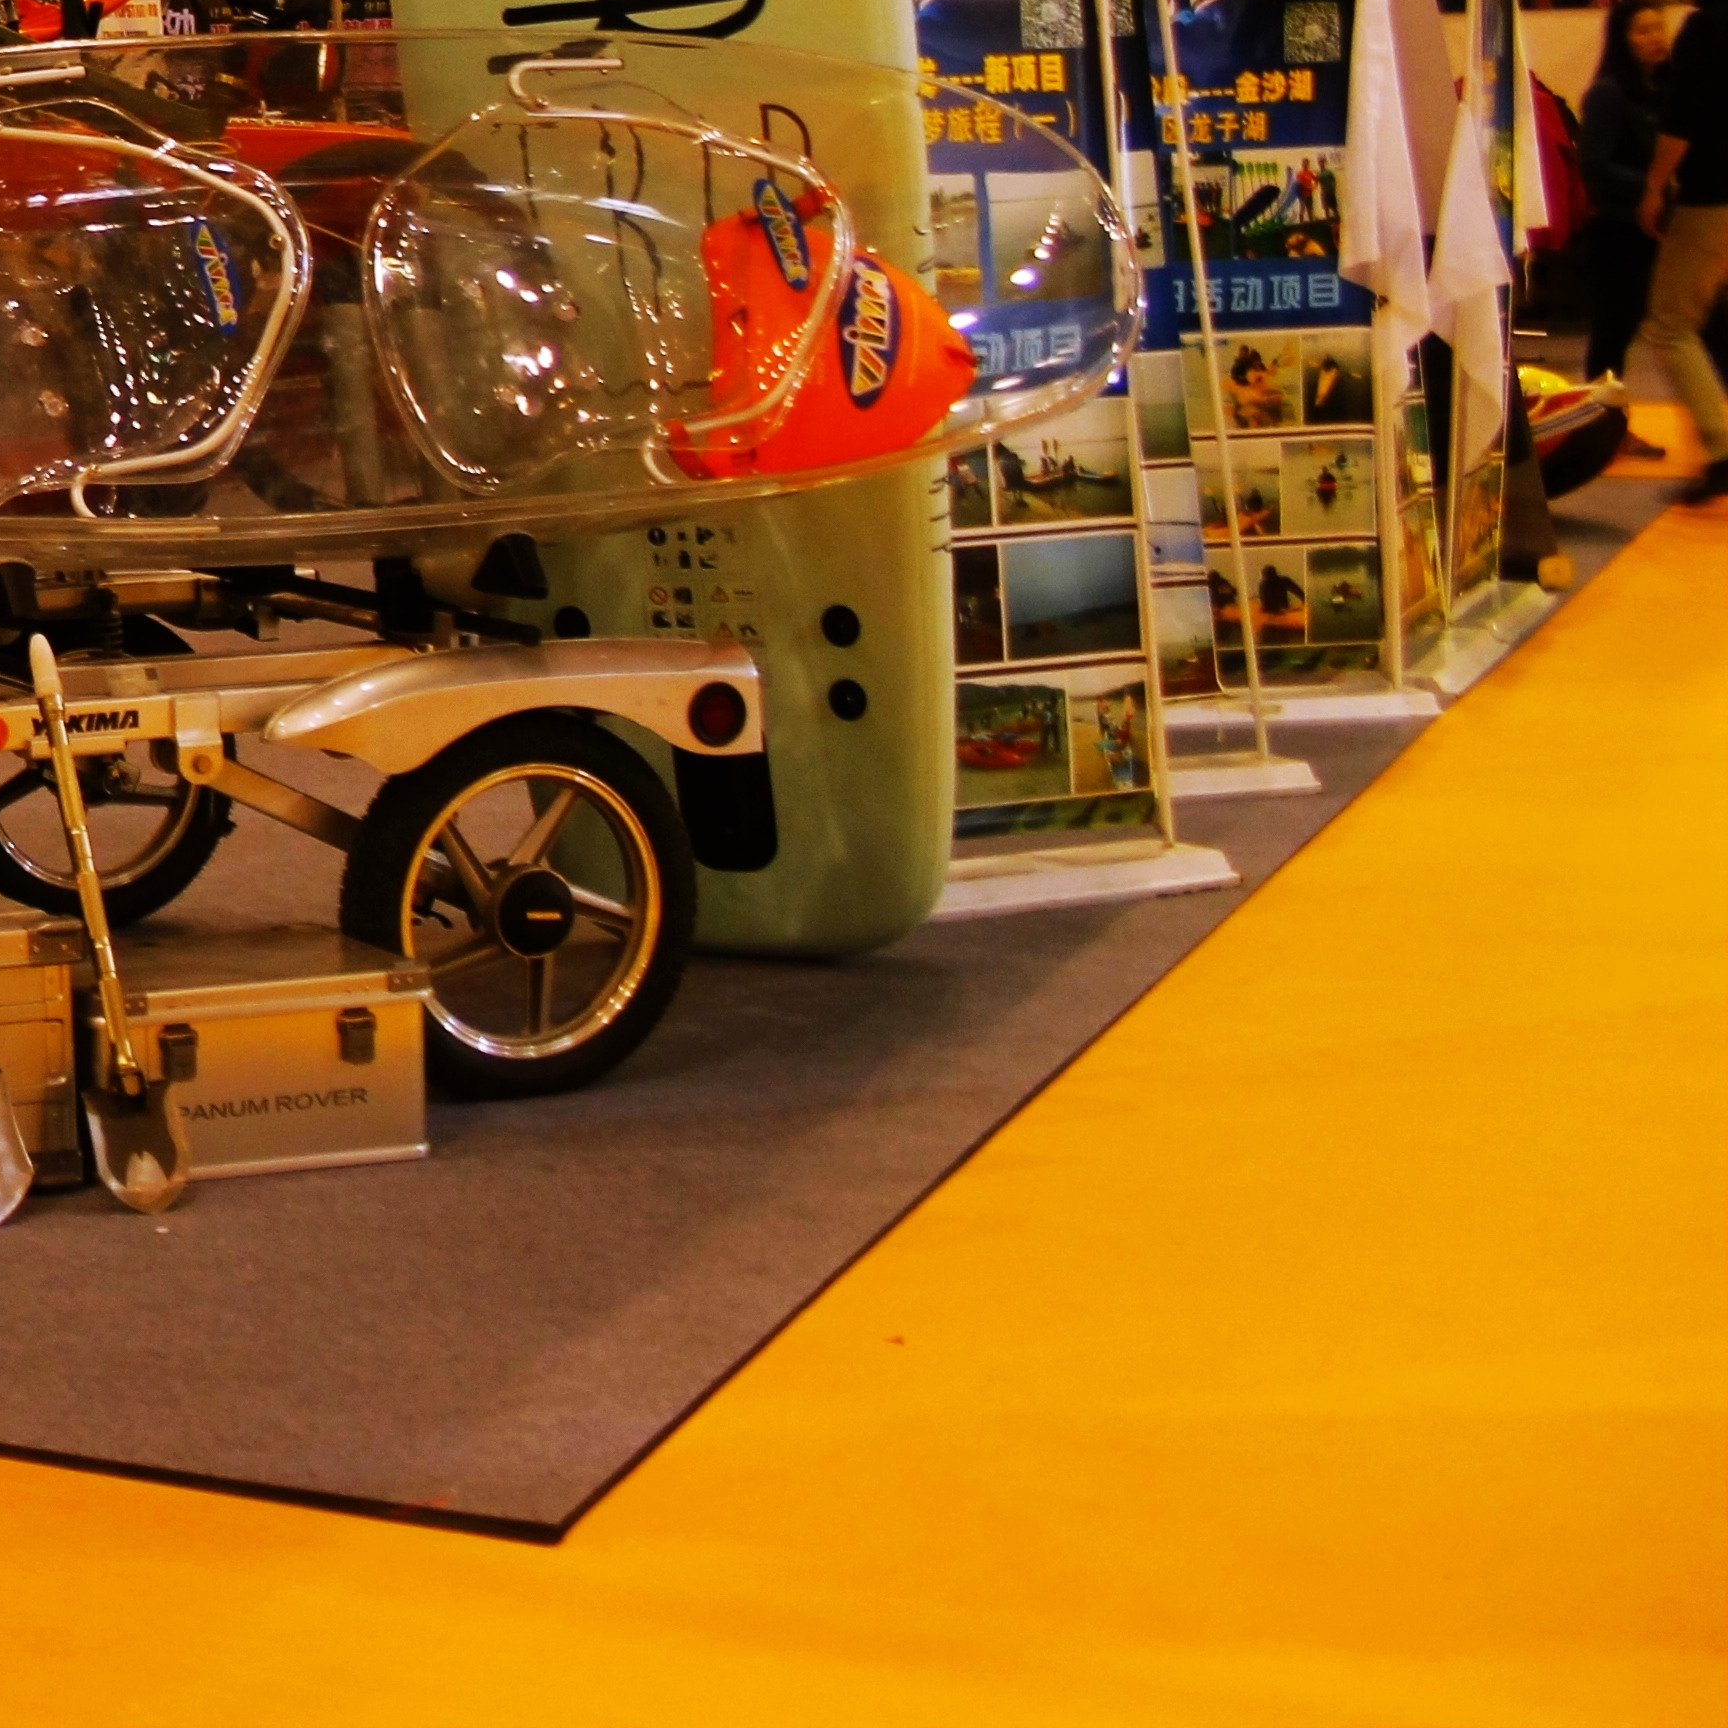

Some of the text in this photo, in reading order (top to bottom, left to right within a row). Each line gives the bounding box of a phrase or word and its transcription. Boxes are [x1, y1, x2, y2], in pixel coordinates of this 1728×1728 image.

[31, 709, 139, 737] YKIMA
[178, 1087, 369, 1122] PANUM ROVER
